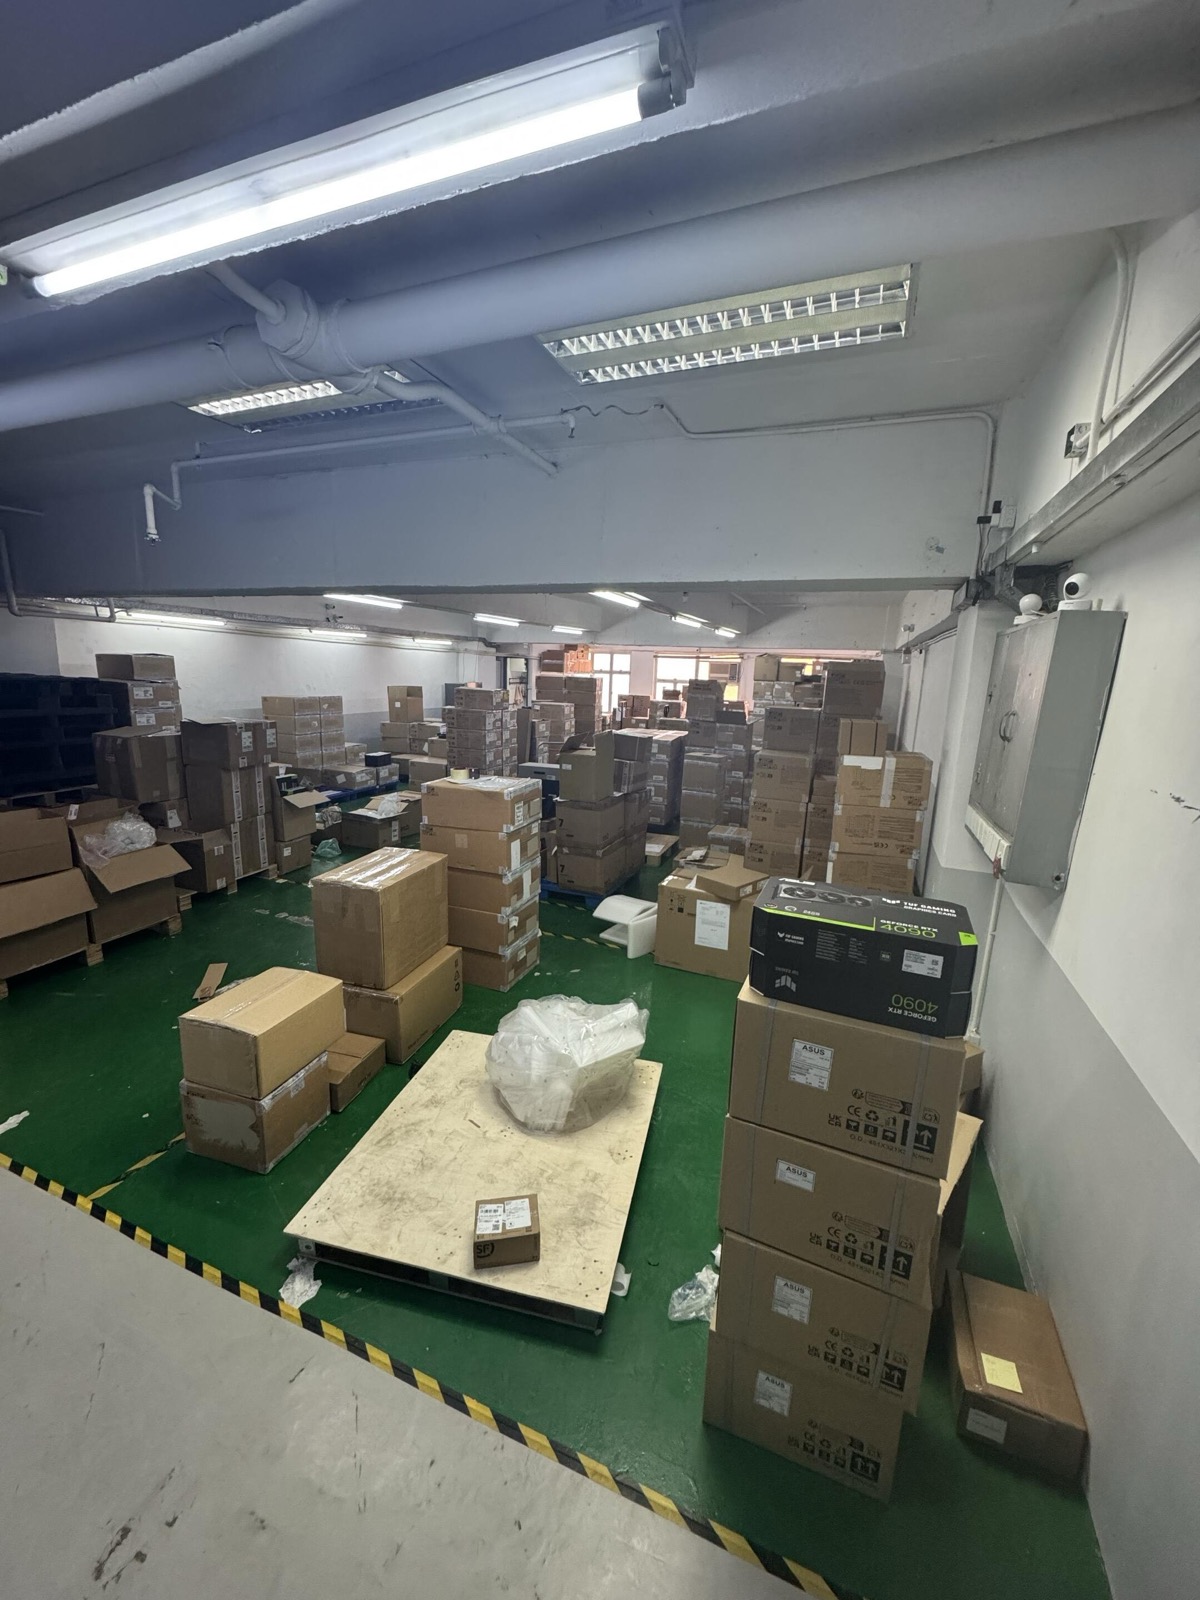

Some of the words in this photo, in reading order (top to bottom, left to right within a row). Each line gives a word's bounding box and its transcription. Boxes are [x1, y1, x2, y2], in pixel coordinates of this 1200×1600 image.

[903, 905, 937, 914] GRAPHICS
[920, 904, 956, 914] GAMING
[880, 919, 919, 929] GEFORCE
[880, 924, 936, 938] 4090
[891, 994, 938, 1014] 4090
[888, 1006, 903, 1015] RTX
[903, 1010, 937, 1022] GEFORCE
[802, 1045, 825, 1056] ASUS
[786, 1166, 808, 1178] ASUS
[783, 1282, 805, 1294] ASUS
